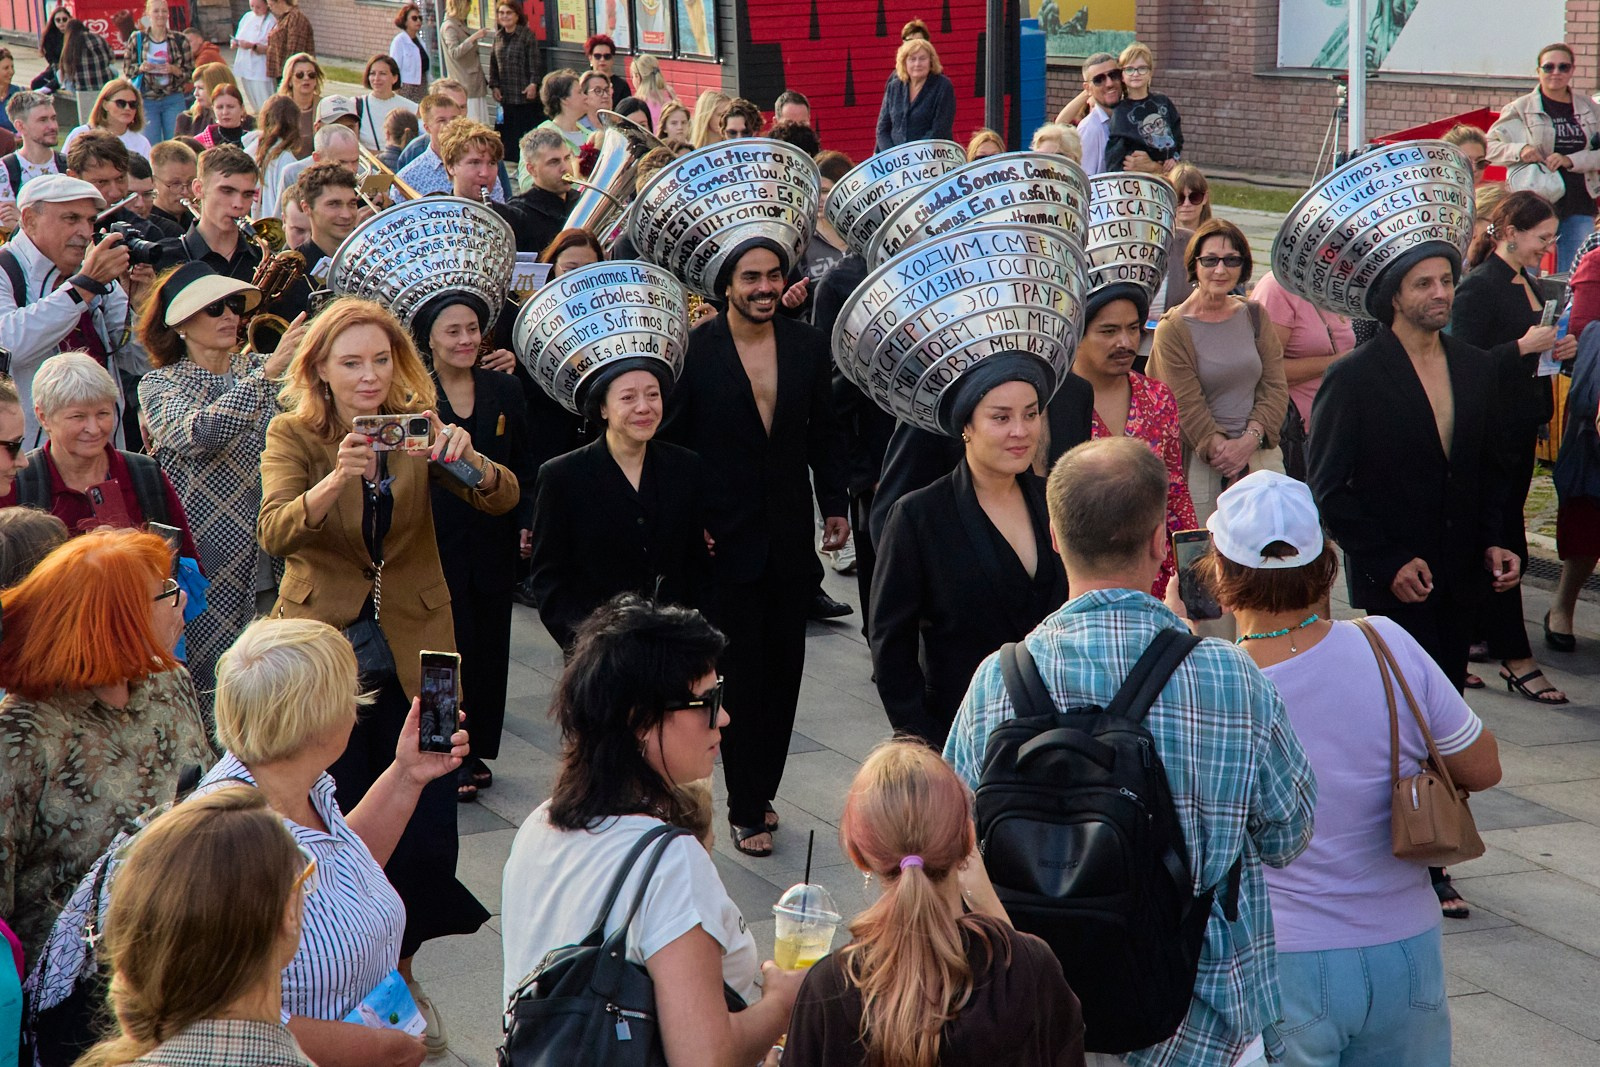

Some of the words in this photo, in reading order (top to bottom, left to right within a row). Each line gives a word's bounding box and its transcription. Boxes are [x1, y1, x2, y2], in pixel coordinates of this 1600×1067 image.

[871, 153, 910, 178] Nous
[915, 147, 956, 161] vivons.
[1320, 162, 1387, 201] Vivimos.
[1386, 151, 1409, 166] En
[1412, 147, 1425, 160] el
[853, 180, 900, 213] vivons.
[901, 169, 939, 186] Avec
[956, 166, 1025, 196] Somos.
[1412, 187, 1432, 202] la
[703, 184, 773, 210] Muerte.
[968, 196, 996, 216] En
[1000, 189, 1016, 205] el
[1334, 203, 1351, 217] la
[1351, 177, 1396, 203] vida,
[1092, 222, 1138, 242] ИСЫ.
[1372, 225, 1389, 243] el
[1403, 226, 1443, 246] Somos
[561, 271, 632, 298] Caminamos.
[862, 279, 898, 316] МЫ.
[898, 237, 989, 285] ХОДИМ.
[992, 233, 1077, 271] СМЕЁМС
[541, 315, 566, 338] Con
[566, 303, 587, 319] los
[590, 287, 645, 310] árboles,
[869, 311, 897, 345] ЭТО
[902, 268, 982, 310] ЖИЗНЬ,
[987, 258, 1074, 292] ГОСПОДА.
[963, 286, 999, 313] ЭТО
[1008, 282, 1064, 312] ТРАУР.
[604, 310, 666, 333] Sufrimos.
[554, 322, 604, 357] hambre.
[592, 345, 613, 363] Es
[615, 337, 628, 355] el
[632, 335, 663, 357] todo.
[916, 321, 982, 365] ПОЁМ.
[986, 310, 1021, 335] МЫ
[1028, 311, 1073, 349] МЕТИС
[548, 350, 561, 368] el
[923, 346, 987, 397] КРОВЬ.
[989, 335, 1019, 350] МЫ
